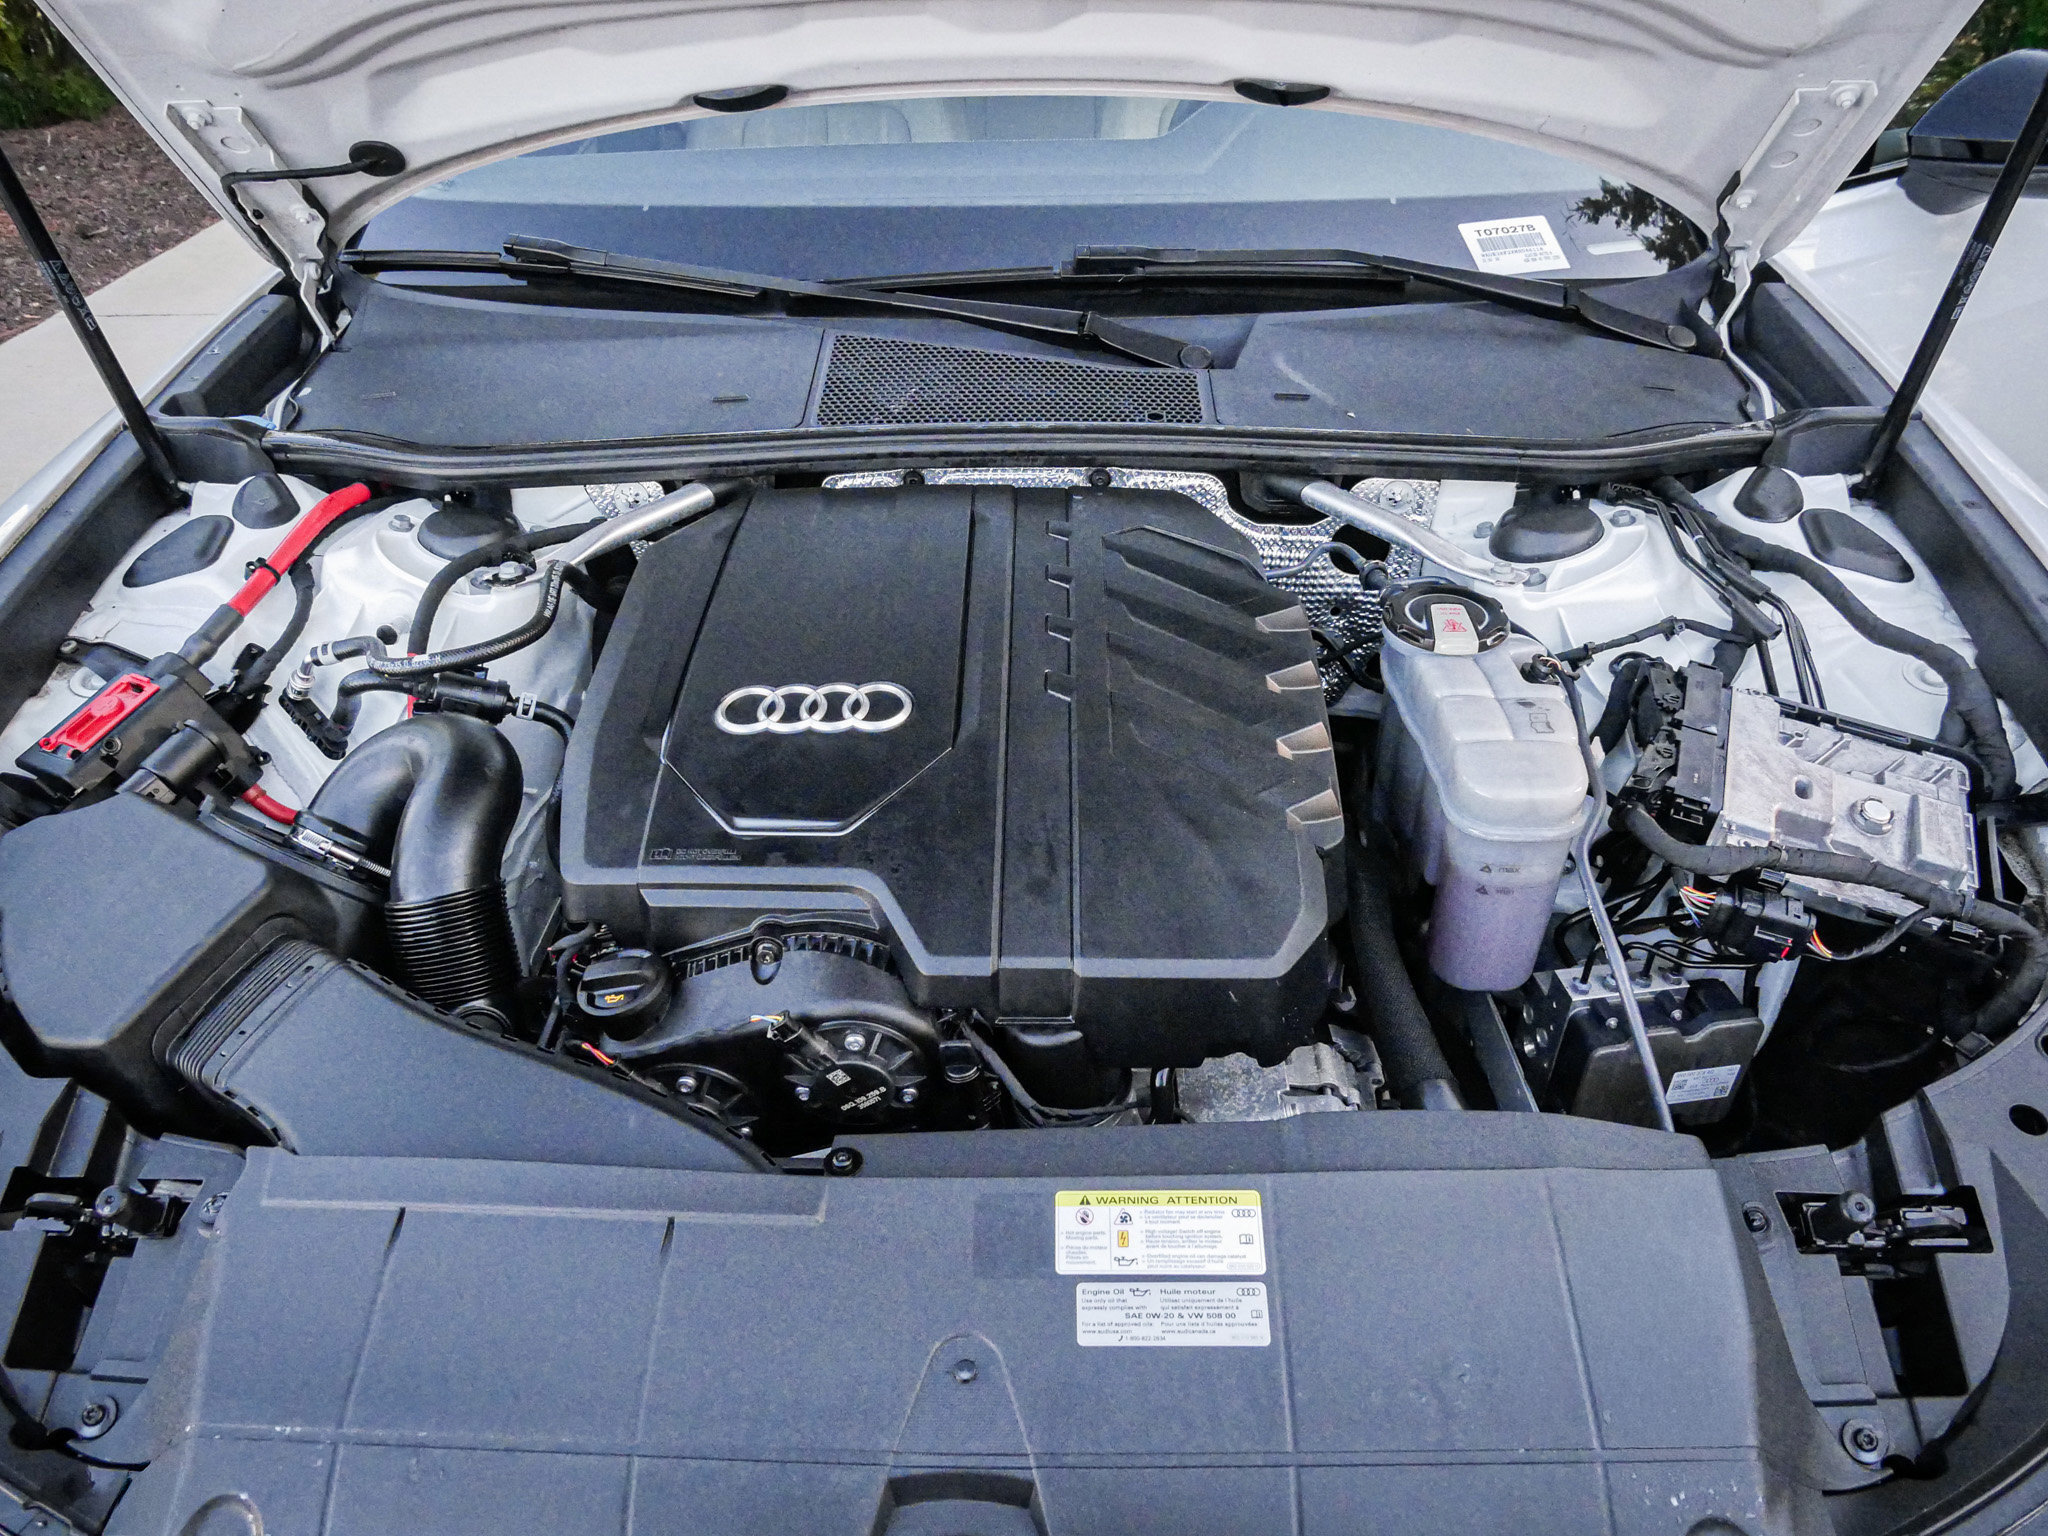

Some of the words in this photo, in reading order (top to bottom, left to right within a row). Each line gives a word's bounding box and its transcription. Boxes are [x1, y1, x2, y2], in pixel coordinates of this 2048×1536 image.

[1474, 224, 1536, 237] T07027B
[1096, 1196, 1159, 1205] WARNING
[1167, 1196, 1238, 1204] ATTENTION
